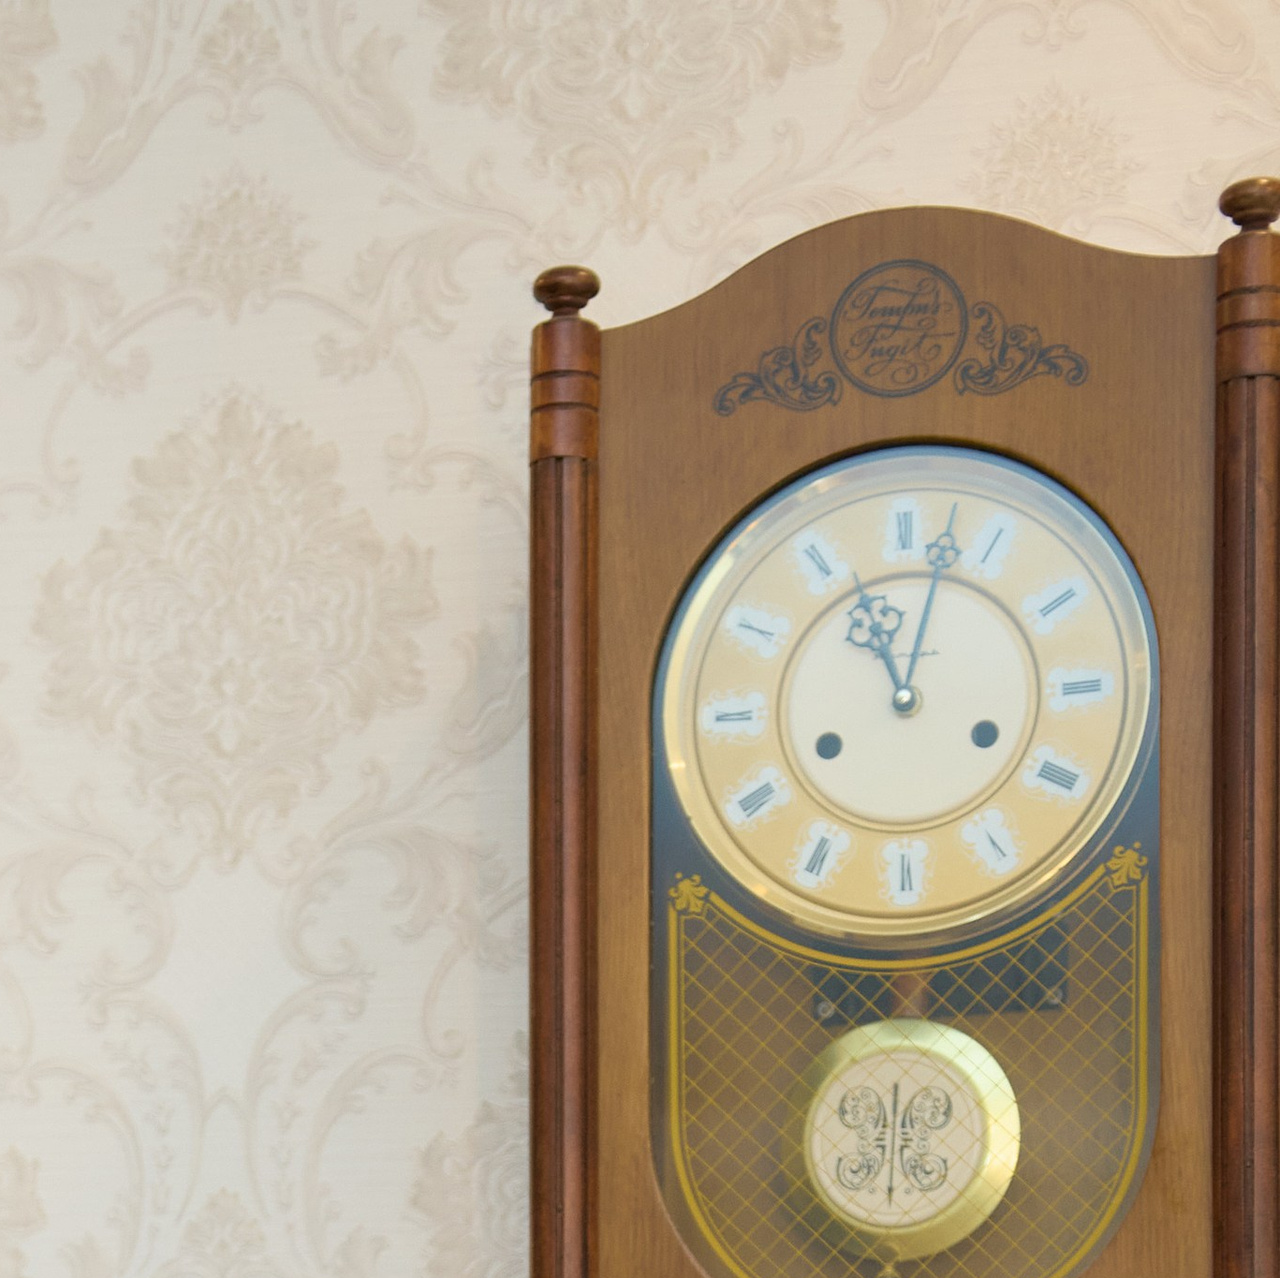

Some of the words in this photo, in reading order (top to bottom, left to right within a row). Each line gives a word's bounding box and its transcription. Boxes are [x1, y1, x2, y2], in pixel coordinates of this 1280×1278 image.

[844, 278, 952, 340] Tempus
[844, 317, 955, 384] Fugit
[895, 511, 914, 550] XII
[980, 527, 1004, 564] I
[804, 543, 833, 577] XI
[1039, 588, 1077, 618] II
[737, 617, 776, 642] X
[1062, 678, 1102, 696] III
[715, 709, 753, 723] IX
[1037, 760, 1080, 791] IIII
[738, 781, 776, 818] VIII
[804, 836, 833, 877] VII
[985, 829, 1008, 861] V
[899, 853, 914, 892] VI
